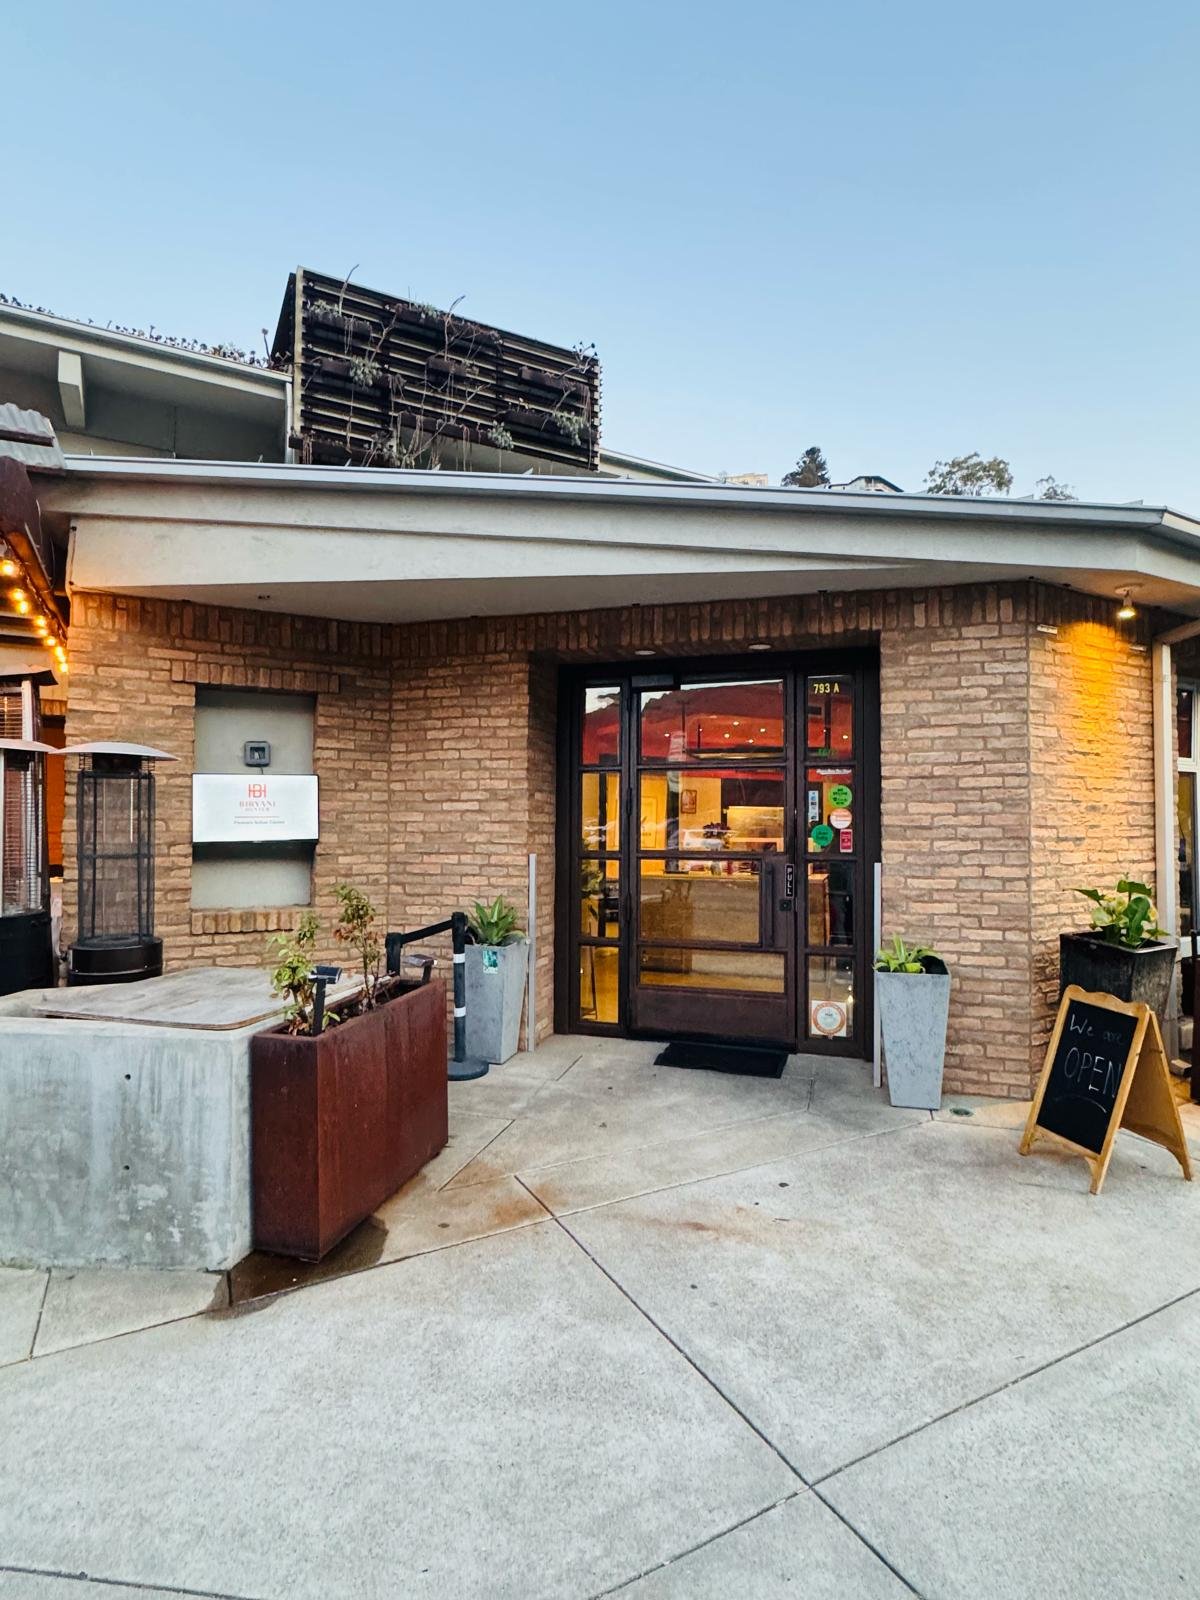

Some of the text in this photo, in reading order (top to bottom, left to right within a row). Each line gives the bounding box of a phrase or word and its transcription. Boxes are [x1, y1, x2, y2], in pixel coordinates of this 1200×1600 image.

[813, 682, 840, 694] 793 A
[1069, 1013, 1124, 1045] We are
[1064, 1046, 1122, 1099] OPEN
